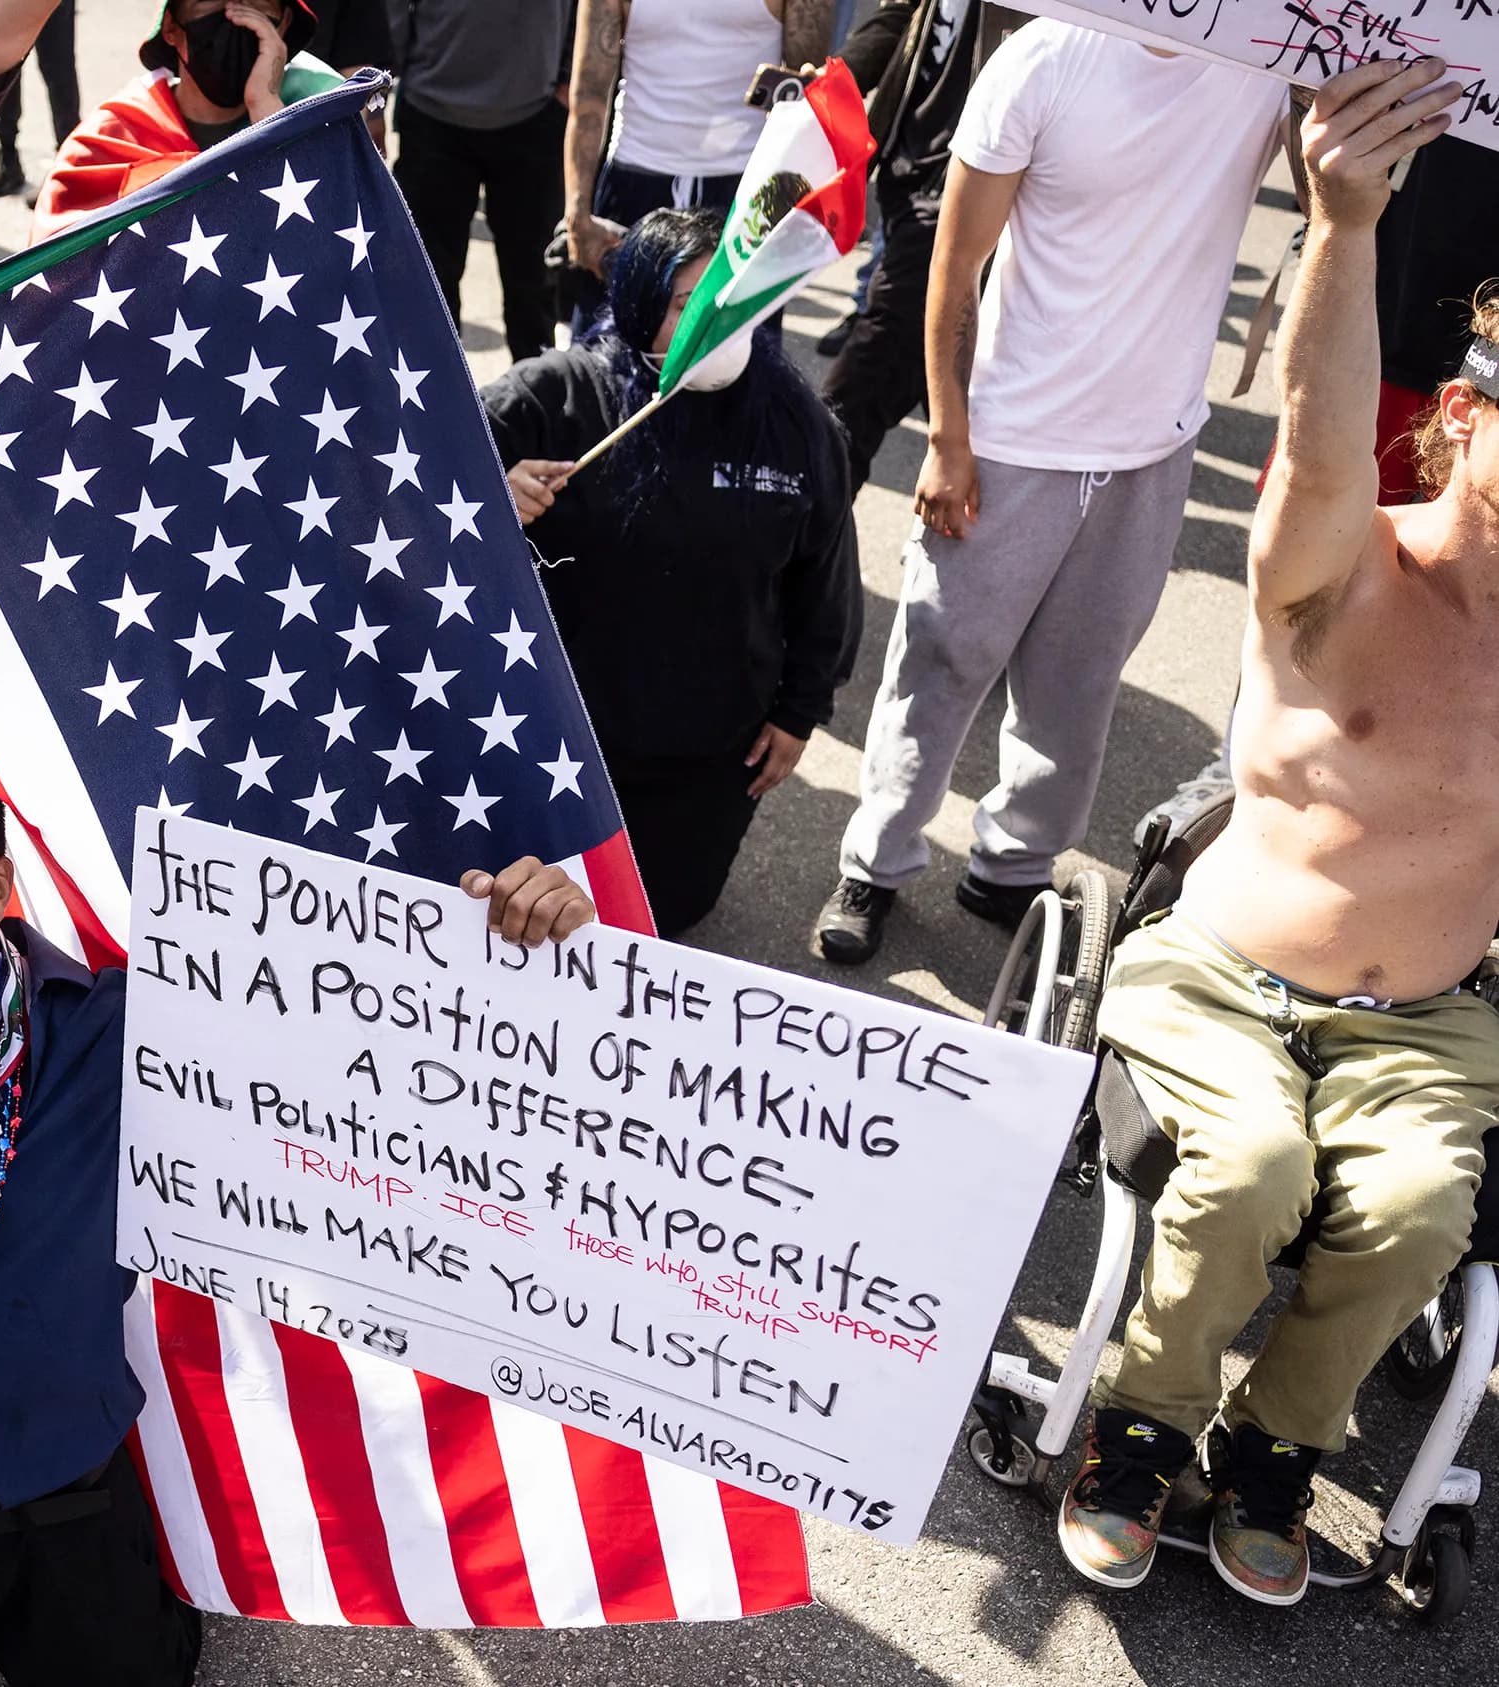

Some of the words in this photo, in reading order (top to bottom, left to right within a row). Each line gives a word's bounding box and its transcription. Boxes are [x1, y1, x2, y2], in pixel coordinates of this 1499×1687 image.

[137, 935, 223, 1002] IN
[246, 956, 289, 1016] A
[590, 1031, 652, 1094] OF
[252, 856, 448, 969] POWER
[554, 940, 598, 991] IN
[734, 987, 990, 1100] PEOPLE
[346, 1049, 382, 1095] A
[130, 1145, 197, 1208] WE
[217, 1178, 309, 1235] WILL
[325, 1207, 470, 1283] MAKE
[490, 1262, 588, 1328] YOU
[130, 1226, 236, 1304] JUNE
[440, 1191, 535, 1237] ICE
[646, 1252, 698, 1284] WHO
